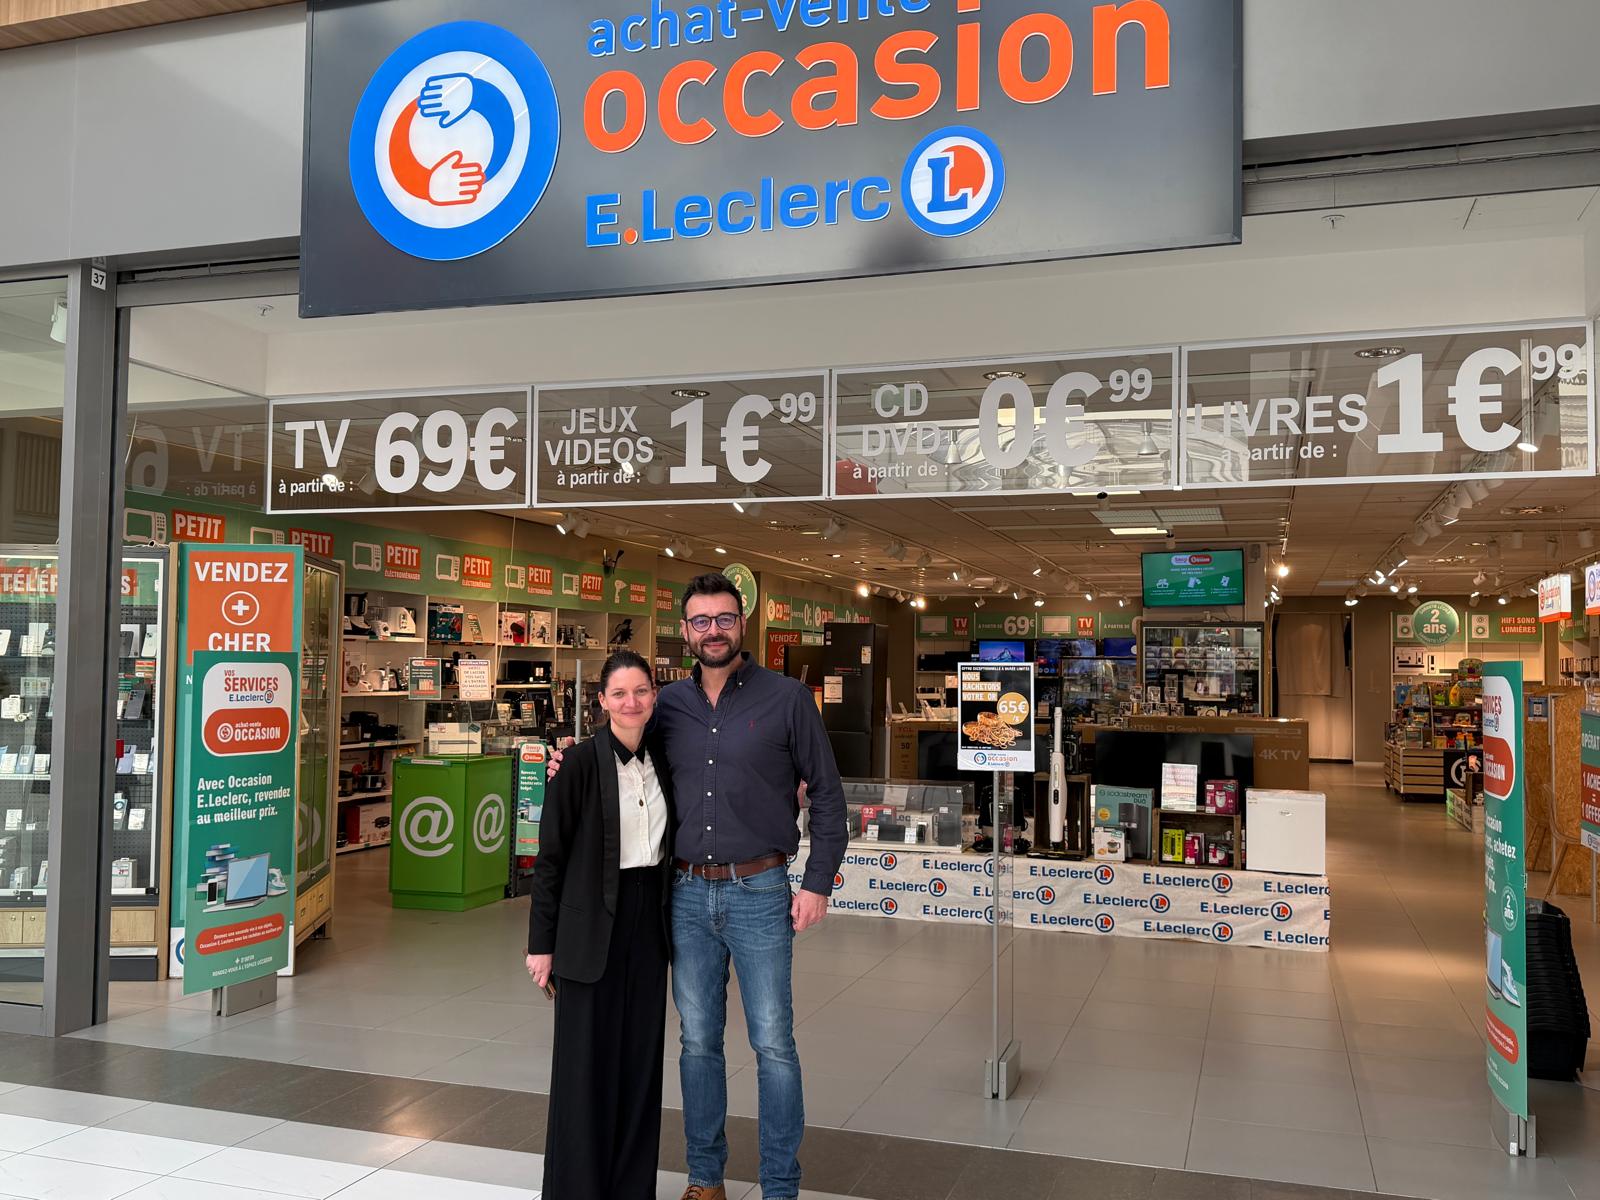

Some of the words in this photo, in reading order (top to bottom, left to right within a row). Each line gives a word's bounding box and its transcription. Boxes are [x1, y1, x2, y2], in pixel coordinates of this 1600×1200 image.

[583, 0, 1170, 153] occasion
[585, 176, 892, 248] E.Leclerc
[93, 273, 106, 286] 37
[875, 383, 929, 418] CD
[1376, 346, 1524, 455] 1€
[1530, 343, 1583, 382] 99
[562, 406, 638, 435] JEUX
[978, 370, 1104, 470] 0€
[1108, 368, 1153, 403] 99
[285, 419, 350, 469] TV
[669, 396, 774, 485] 1€
[779, 392, 816, 424] 99
[862, 423, 941, 457] DVD
[374, 408, 519, 494] 69€
[544, 436, 654, 466] VIDEOS
[1300, 442, 1325, 459] de
[557, 471, 565, 486] à
[570, 469, 609, 488] partir
[853, 464, 862, 479] à
[868, 462, 912, 482] partir
[918, 461, 938, 477] de
[279, 481, 286, 493] à
[290, 479, 325, 497] partir
[327, 479, 345, 492] de
[175, 513, 222, 540] PETIT
[292, 531, 331, 555] PETIT
[386, 544, 419, 567] PETIT
[195, 562, 288, 583] VENDEZ
[463, 556, 491, 577] PETIT
[528, 566, 551, 584] PETIT
[581, 575, 602, 591] PETIT
[954, 617, 968, 628] TV
[1078, 617, 1093, 628] TV
[1430, 609, 1440, 623] 2
[1004, 615, 1035, 636] 69€
[1423, 622, 1447, 634] ans
[208, 632, 271, 653] CHER
[769, 634, 798, 643] VENDEZ
[224, 677, 279, 692] SERVICES
[962, 672, 980, 681] NOUS
[229, 693, 264, 703] E.Leclerc
[962, 692, 985, 701] VOTRE
[999, 700, 1028, 714] 65€
[235, 727, 281, 742] OCCASION
[1259, 749, 1277, 760] 4K
[1281, 750, 1302, 761] TV
[197, 778, 225, 791] Avec
[228, 773, 272, 788] Occasion
[197, 792, 252, 808] E.Leclerc,
[254, 786, 291, 802] revendez
[1106, 790, 1148, 799] sodastream
[1133, 797, 1147, 805] DUO
[197, 813, 211, 825] au
[214, 807, 257, 823] meilleur
[259, 804, 278, 820] prix.
[1494, 837, 1517, 859] achetez
[841, 853, 879, 866] eclerc
[922, 859, 983, 873] E.Leclerc
[1029, 864, 1093, 882] E.Leclerc
[1143, 872, 1210, 890] E.Leclerc
[869, 878, 927, 893] E.Leclerc
[828, 899, 878, 911] .Leclerc
[1083, 892, 1148, 909] E.Leclerc
[1199, 901, 1270, 918] E.Leclerc
[923, 905, 983, 919] E.Leclerc
[1029, 912, 1094, 930] E.Leclerc
[1143, 920, 1210, 938] E.Leclerc
